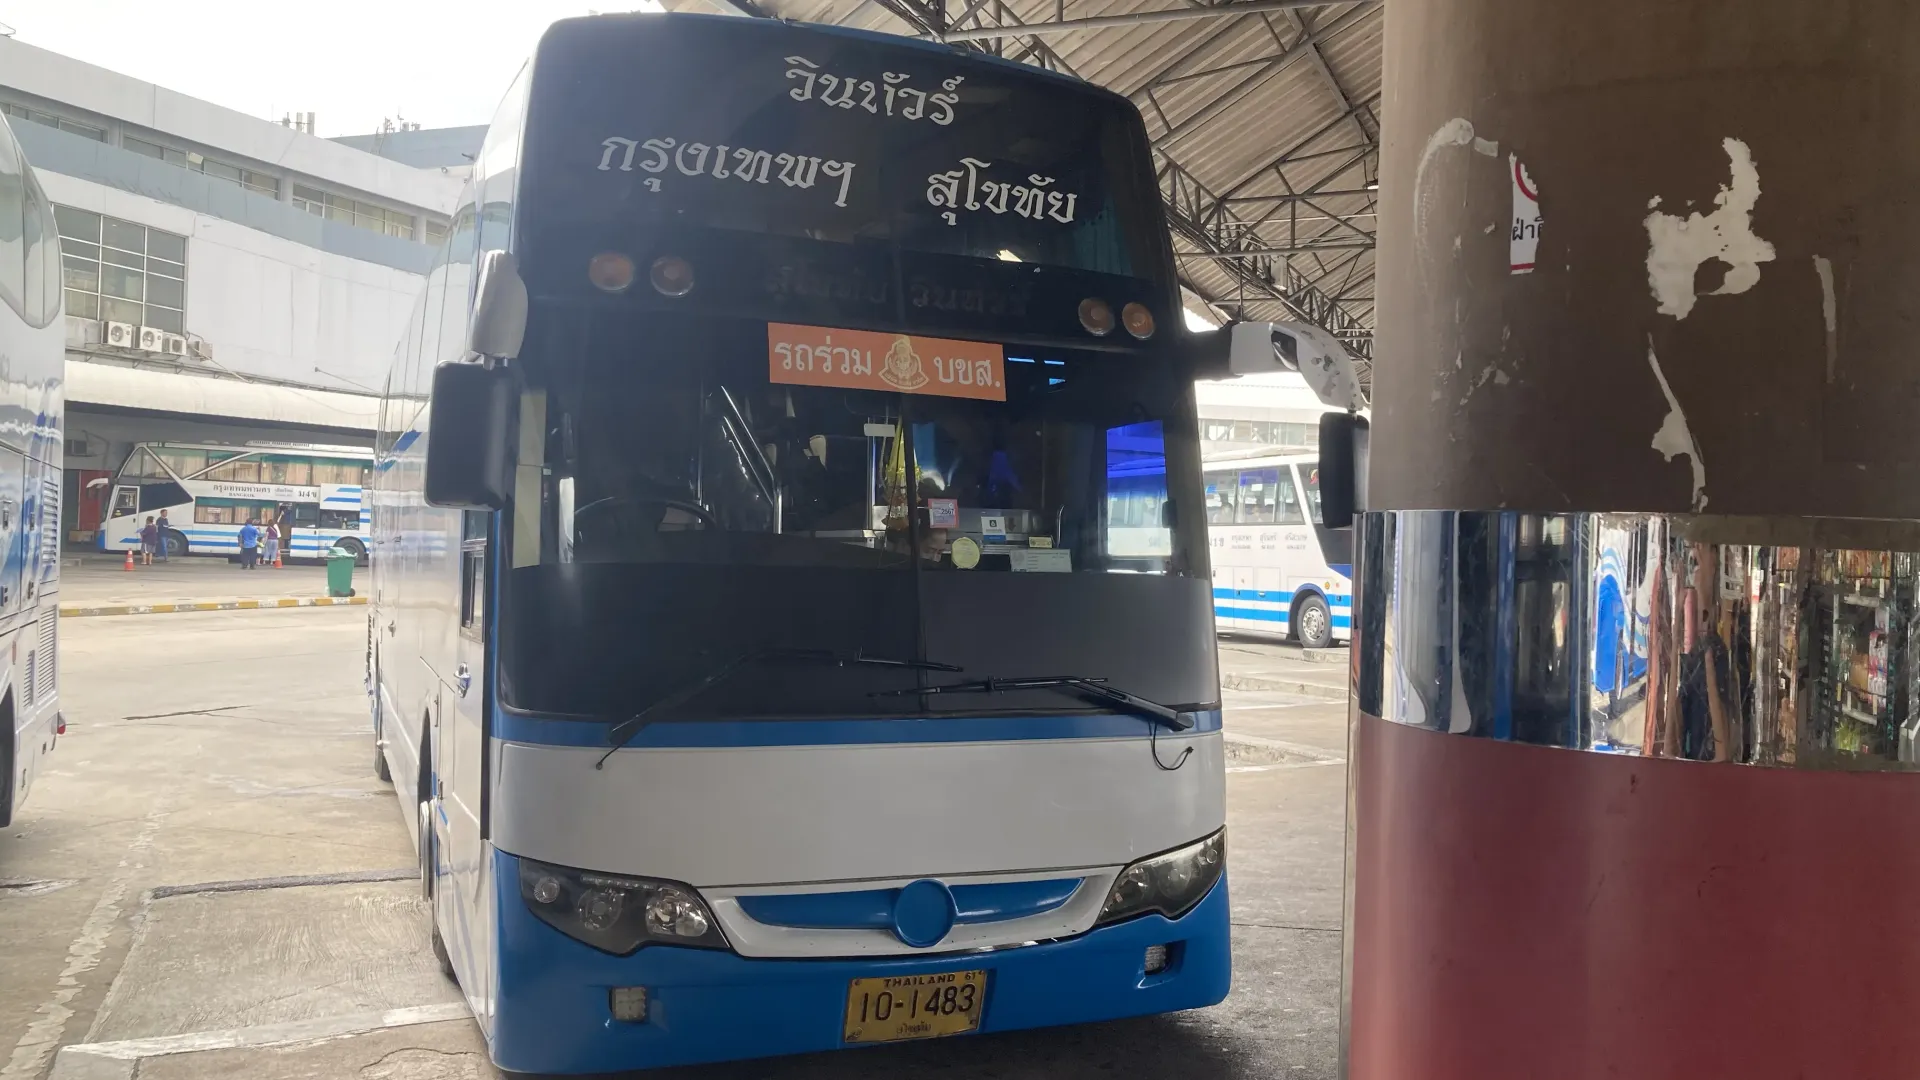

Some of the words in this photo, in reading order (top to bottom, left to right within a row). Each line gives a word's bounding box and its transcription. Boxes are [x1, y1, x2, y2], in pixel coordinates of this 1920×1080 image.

[784, 55, 966, 126] วินทัวร์
[597, 136, 857, 208] กรุงเทพฯ
[926, 157, 1078, 226] สุโขทัย
[774, 336, 872, 376] รถร่วม
[934, 356, 1001, 388] บขส.
[860, 983, 976, 1023] 10-1483
[884, 973, 956, 988] THAILAND
